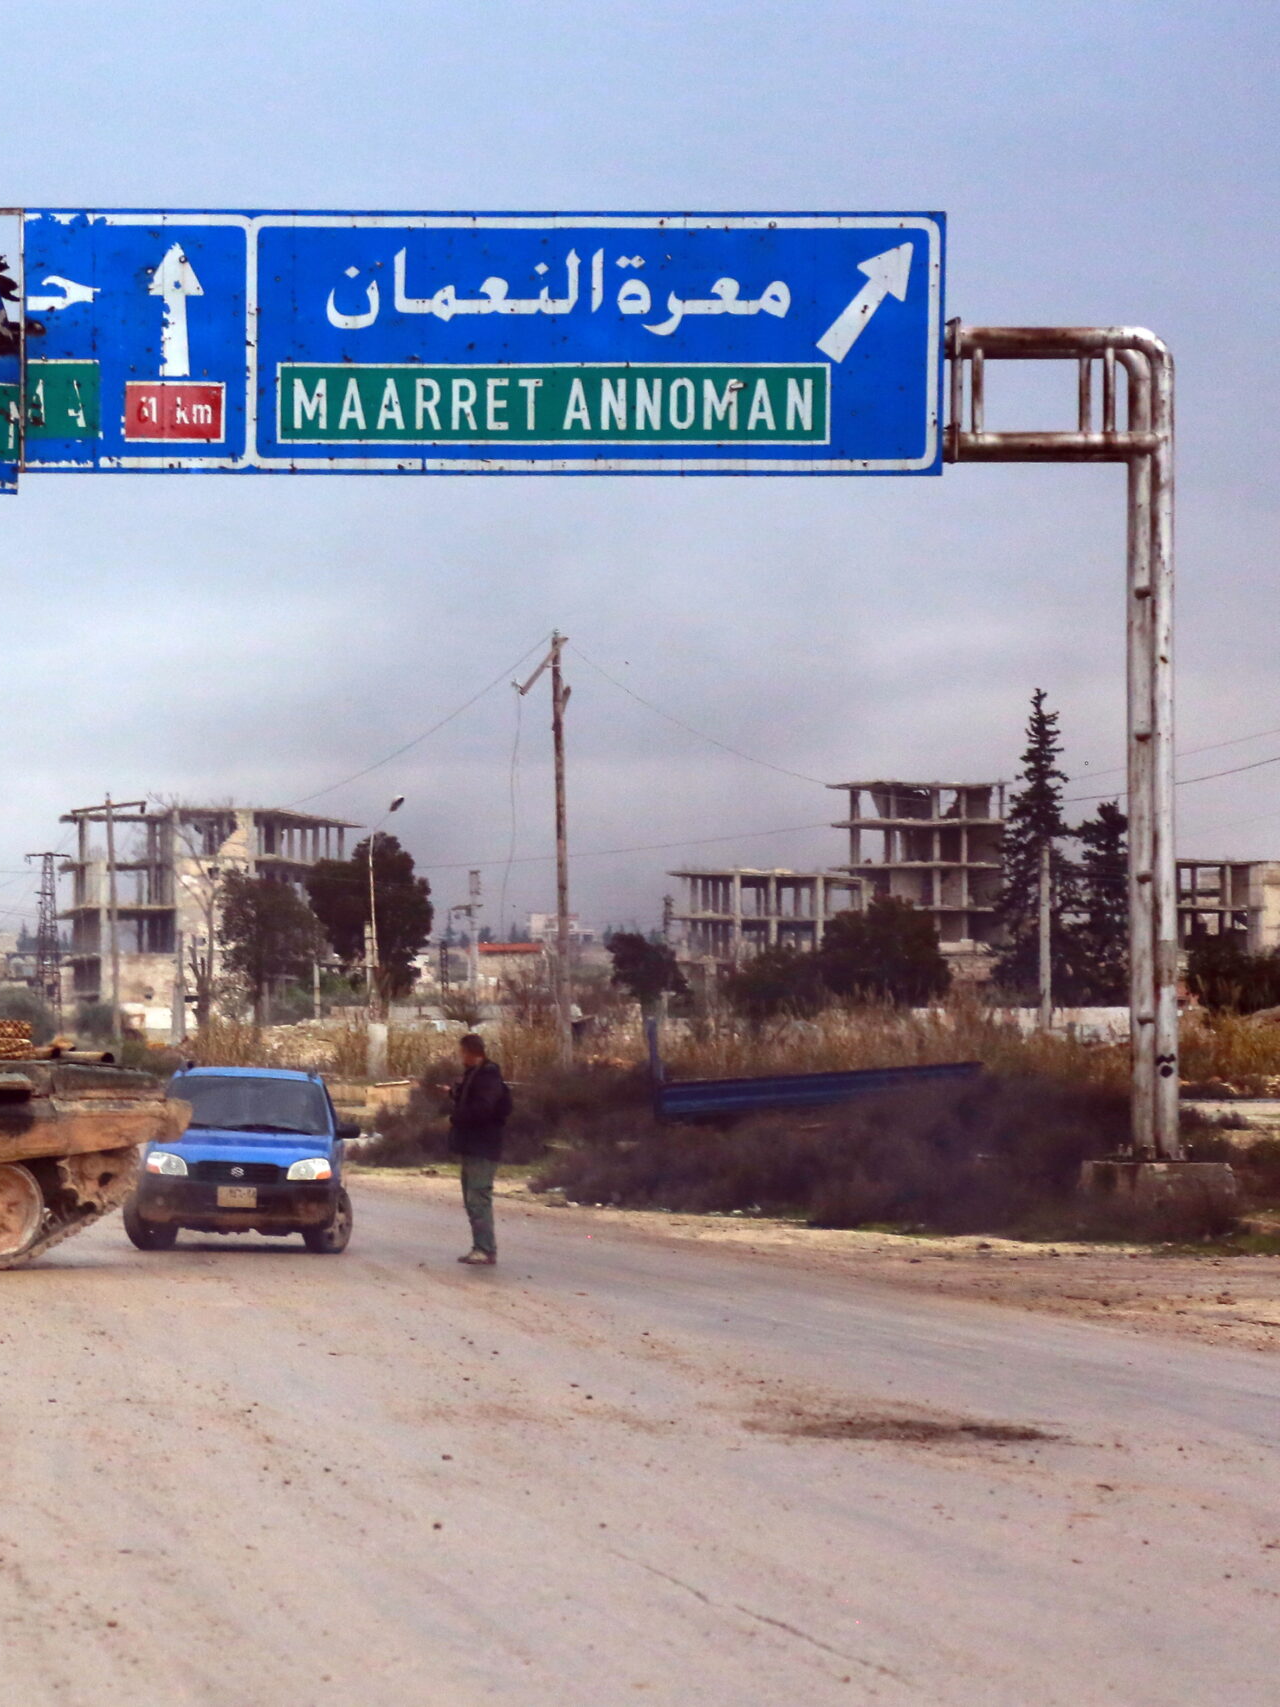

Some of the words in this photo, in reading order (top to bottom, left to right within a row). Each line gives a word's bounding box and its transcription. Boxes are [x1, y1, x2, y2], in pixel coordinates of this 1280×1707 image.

[326, 247, 605, 330] النعمان
[616, 255, 791, 336] معرة
[176, 396, 213, 425] km
[292, 377, 545, 431] MAARRET
[562, 376, 814, 431] ANNOMAN
